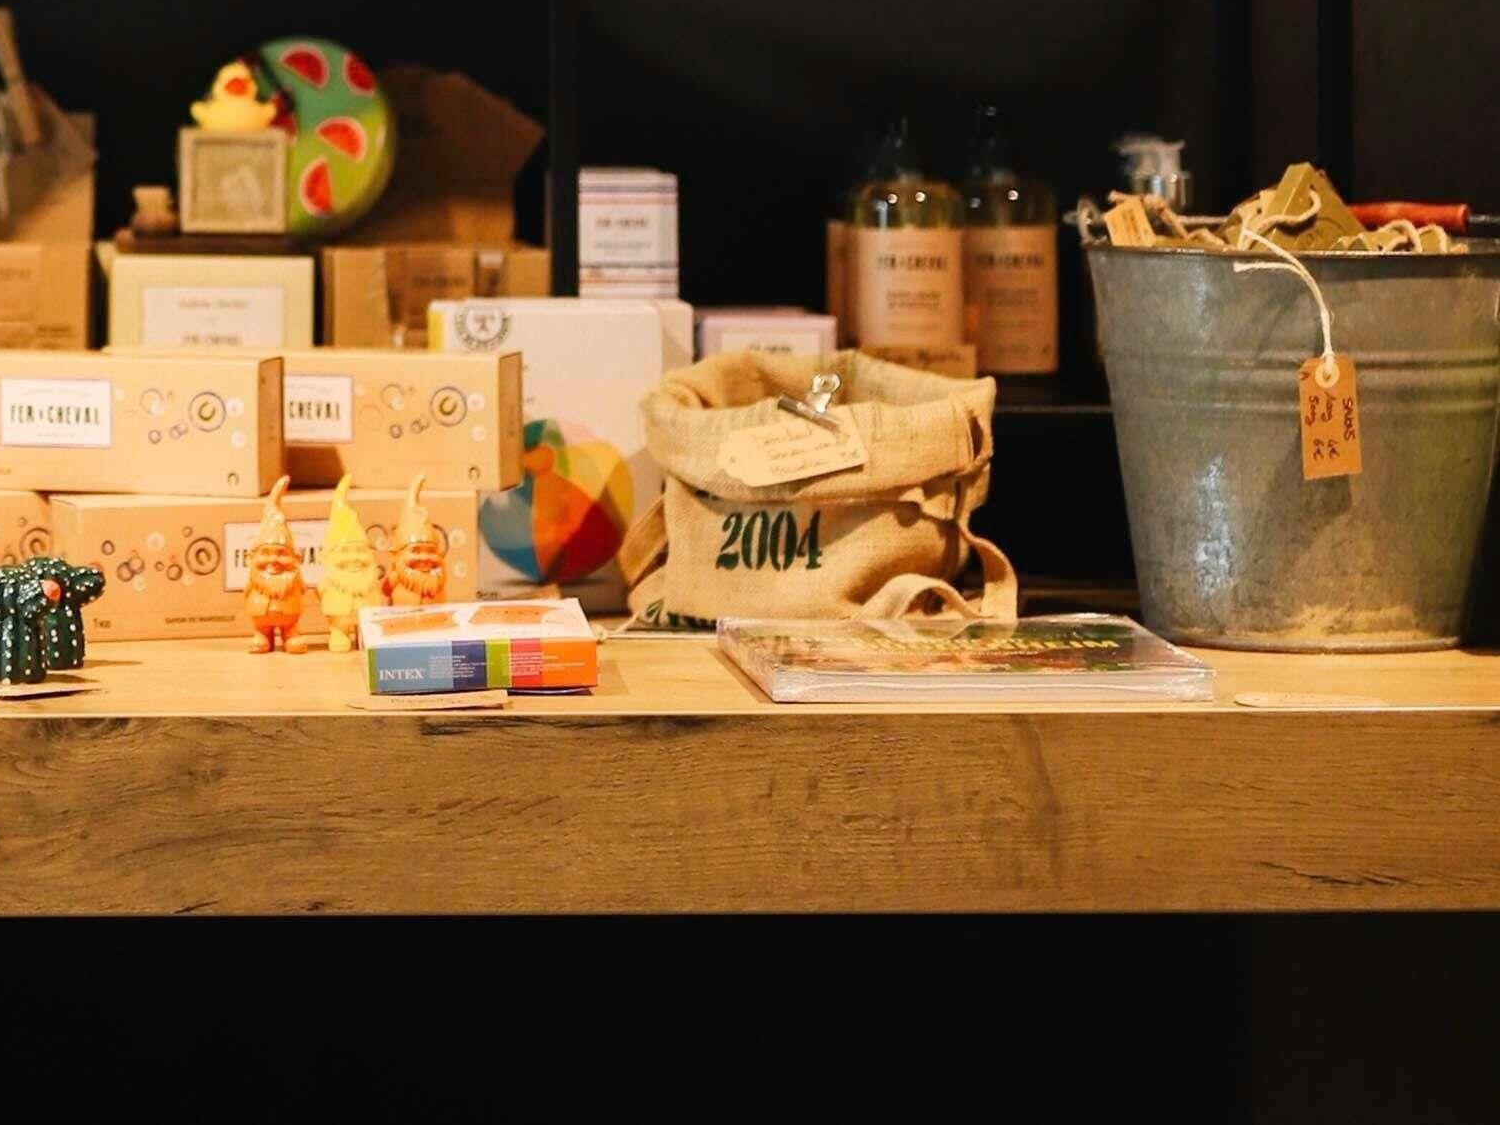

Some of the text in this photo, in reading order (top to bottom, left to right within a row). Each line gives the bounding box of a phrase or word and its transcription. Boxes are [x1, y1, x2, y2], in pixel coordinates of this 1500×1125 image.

[9, 404, 36, 425] FER
[46, 404, 101, 427] CHEVAL
[288, 400, 342, 422] CHEVAL
[715, 508, 823, 572] 2004
[378, 667, 424, 681] INTEX
